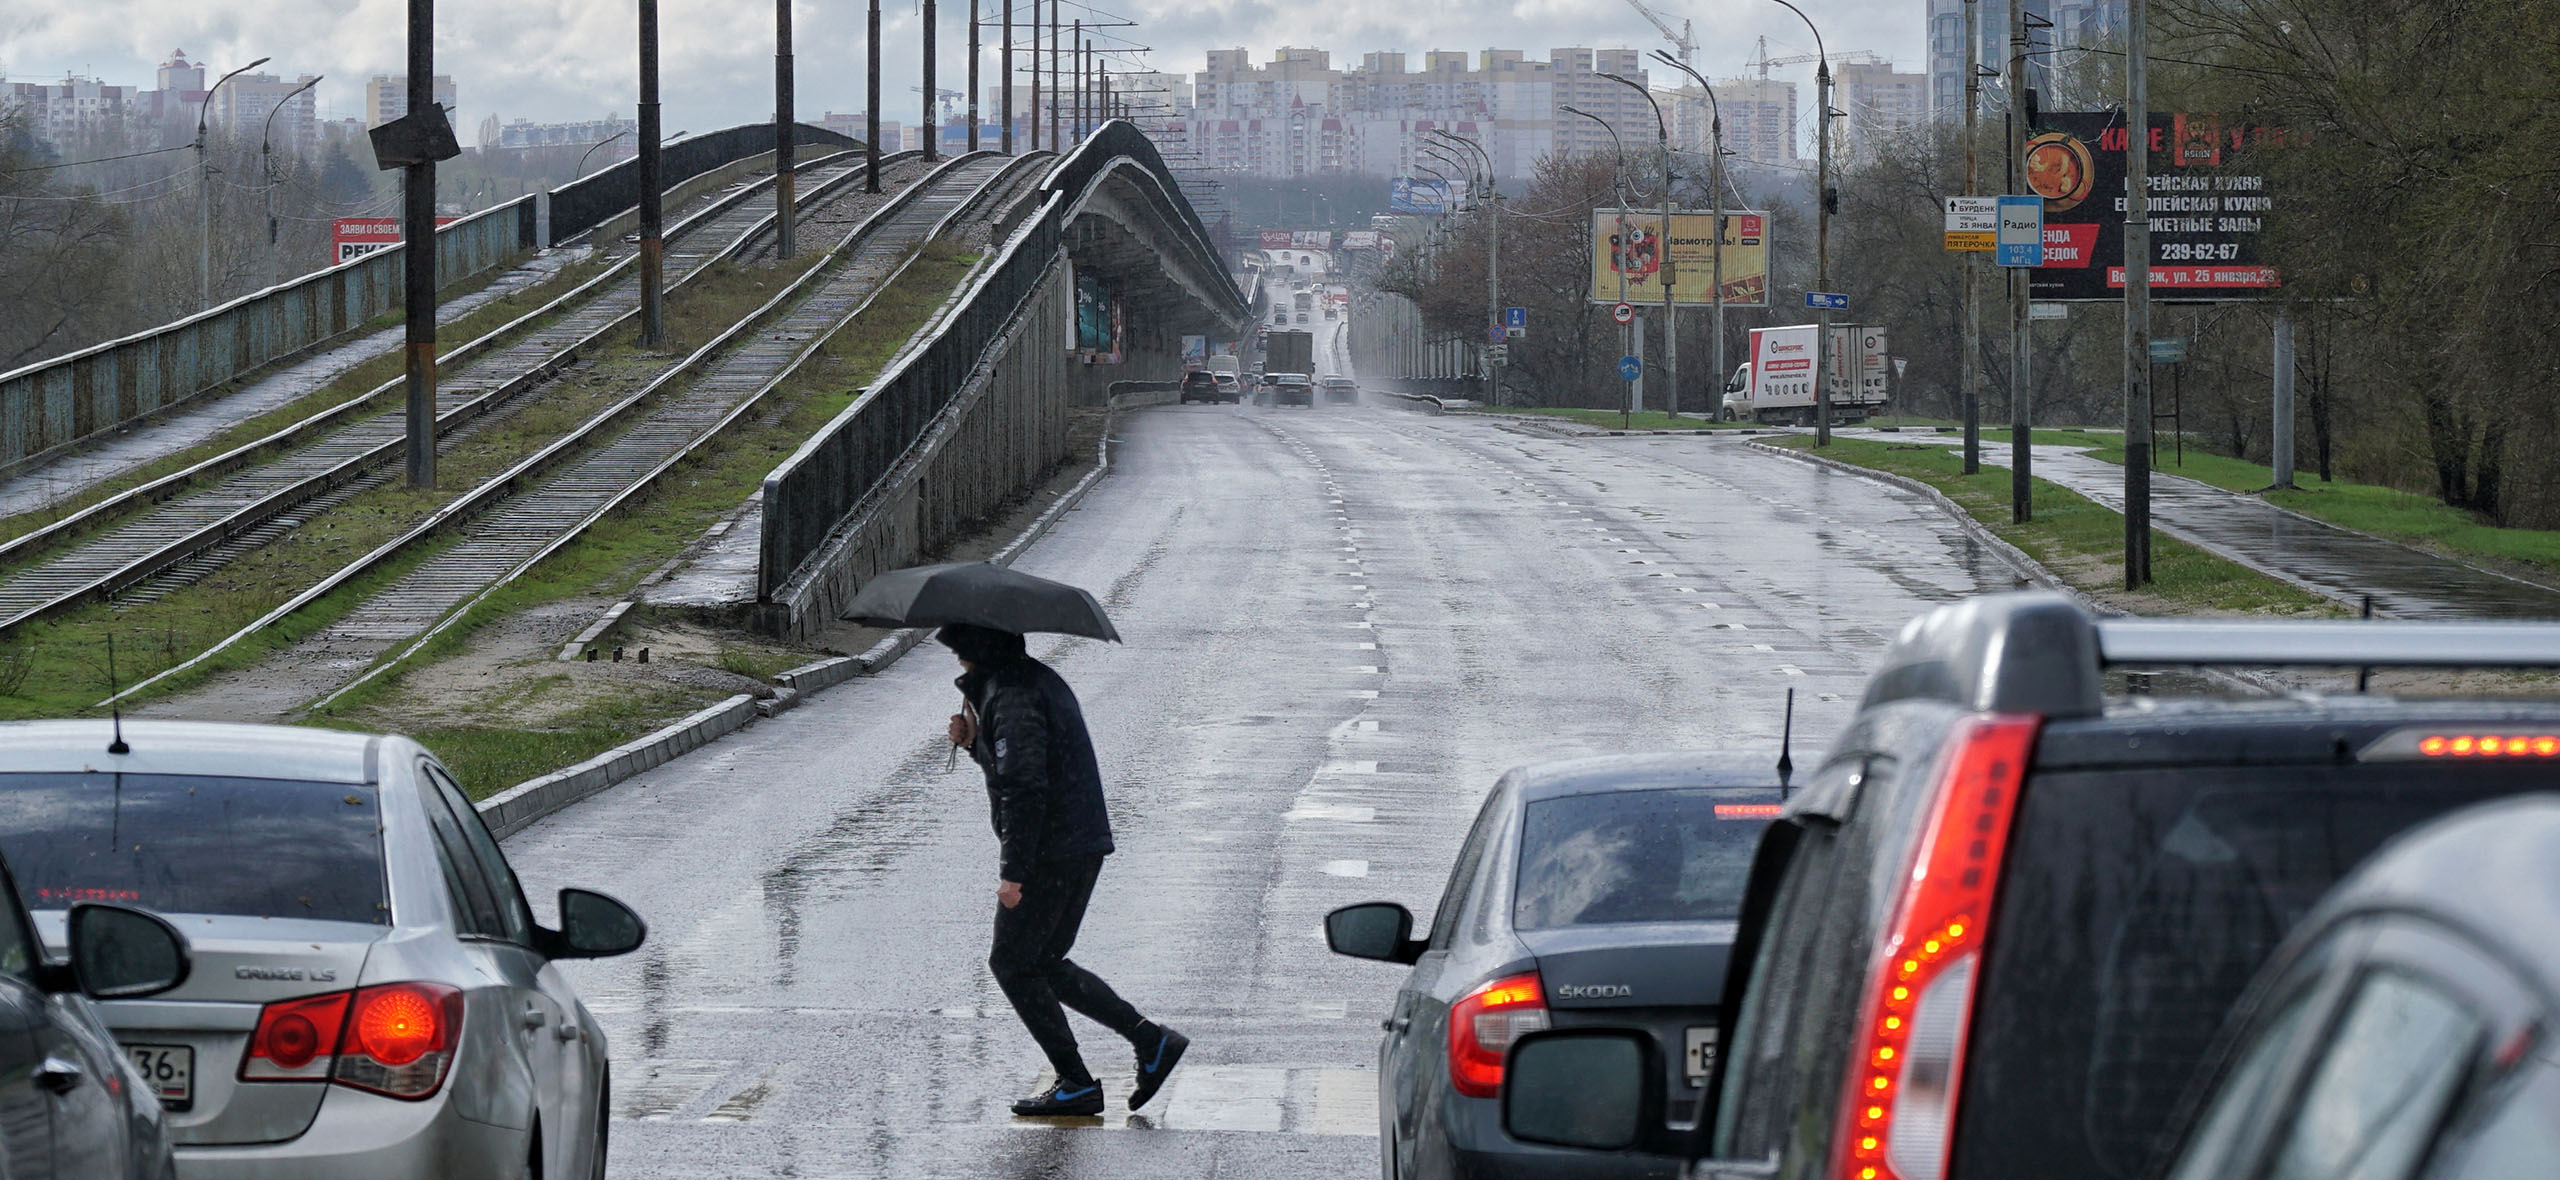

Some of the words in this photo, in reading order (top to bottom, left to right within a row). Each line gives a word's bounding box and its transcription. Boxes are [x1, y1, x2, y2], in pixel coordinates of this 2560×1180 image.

[2101, 127, 2163, 150] КАЕ
[2124, 173, 2209, 191] РЕЙСКАЯ
[2215, 176, 2262, 191] КУХНЯ
[2115, 195, 2218, 211] ЕОПЕЙСКАЯ
[2225, 197, 2272, 211] КУХНЯ
[340, 224, 366, 234] ЗАЯВИ
[367, 224, 372, 234] О
[373, 224, 400, 234] СВОЕМ
[2003, 220, 2037, 230] Радио
[2150, 218, 2213, 232] КЕТНЫЕ
[2219, 217, 2261, 232] ЗАЛЫ
[2042, 230, 2071, 243] ЕНДА
[2042, 248, 2079, 261] СЕДОК
[2161, 243, 2239, 260] 239-62-67
[2011, 256, 2031, 264] МГц
[2173, 271, 2191, 284] ул.
[2195, 269, 2210, 283] 25
[235, 966, 303, 980] CRUZE
[310, 968, 336, 981] LS
[1559, 984, 1632, 999] ŠKODA
